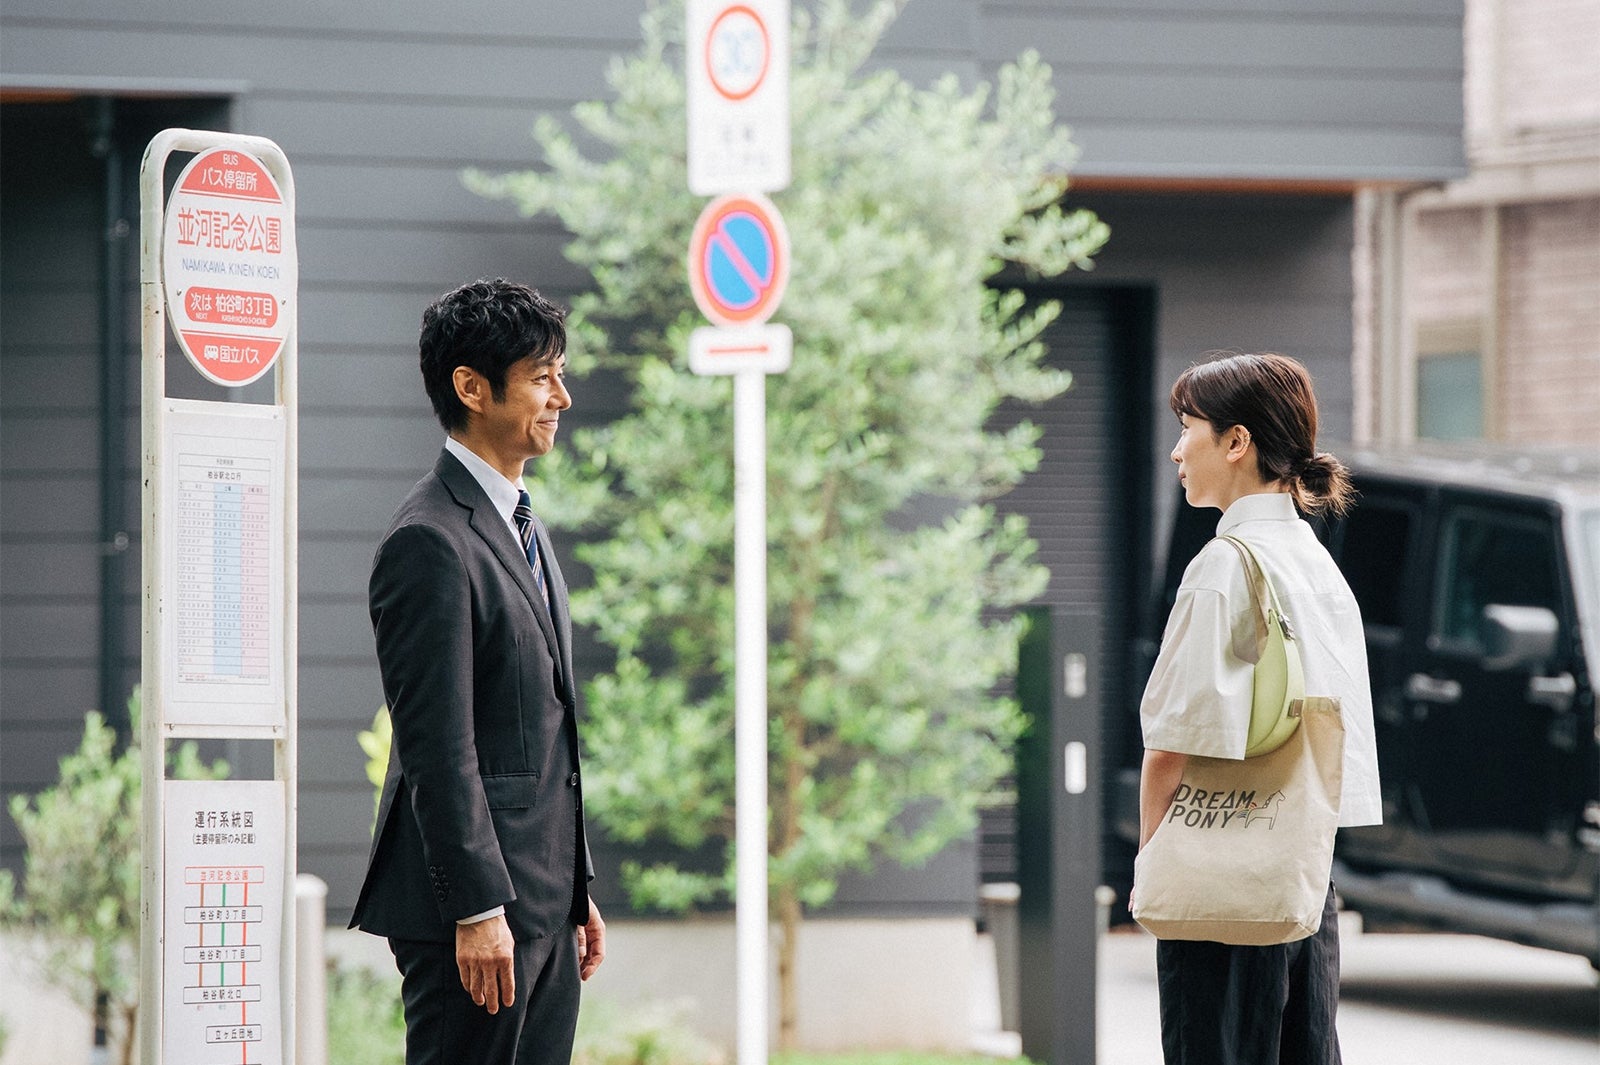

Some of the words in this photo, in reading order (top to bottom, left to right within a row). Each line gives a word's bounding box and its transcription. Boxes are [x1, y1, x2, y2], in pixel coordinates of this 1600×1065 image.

[222, 153, 239, 166] BUS
[201, 168, 258, 192] バス停留所
[177, 207, 282, 254] 並河記念公園
[182, 258, 227, 274] NAMIKAWA
[228, 263, 255, 278] KINEN
[256, 267, 280, 280] KOEN
[190, 292, 212, 312] 次は
[219, 345, 260, 365] 国立バス
[1173, 783, 1256, 810] DREAM
[194, 810, 254, 829] 運行系統図
[1168, 804, 1237, 829] PONY
